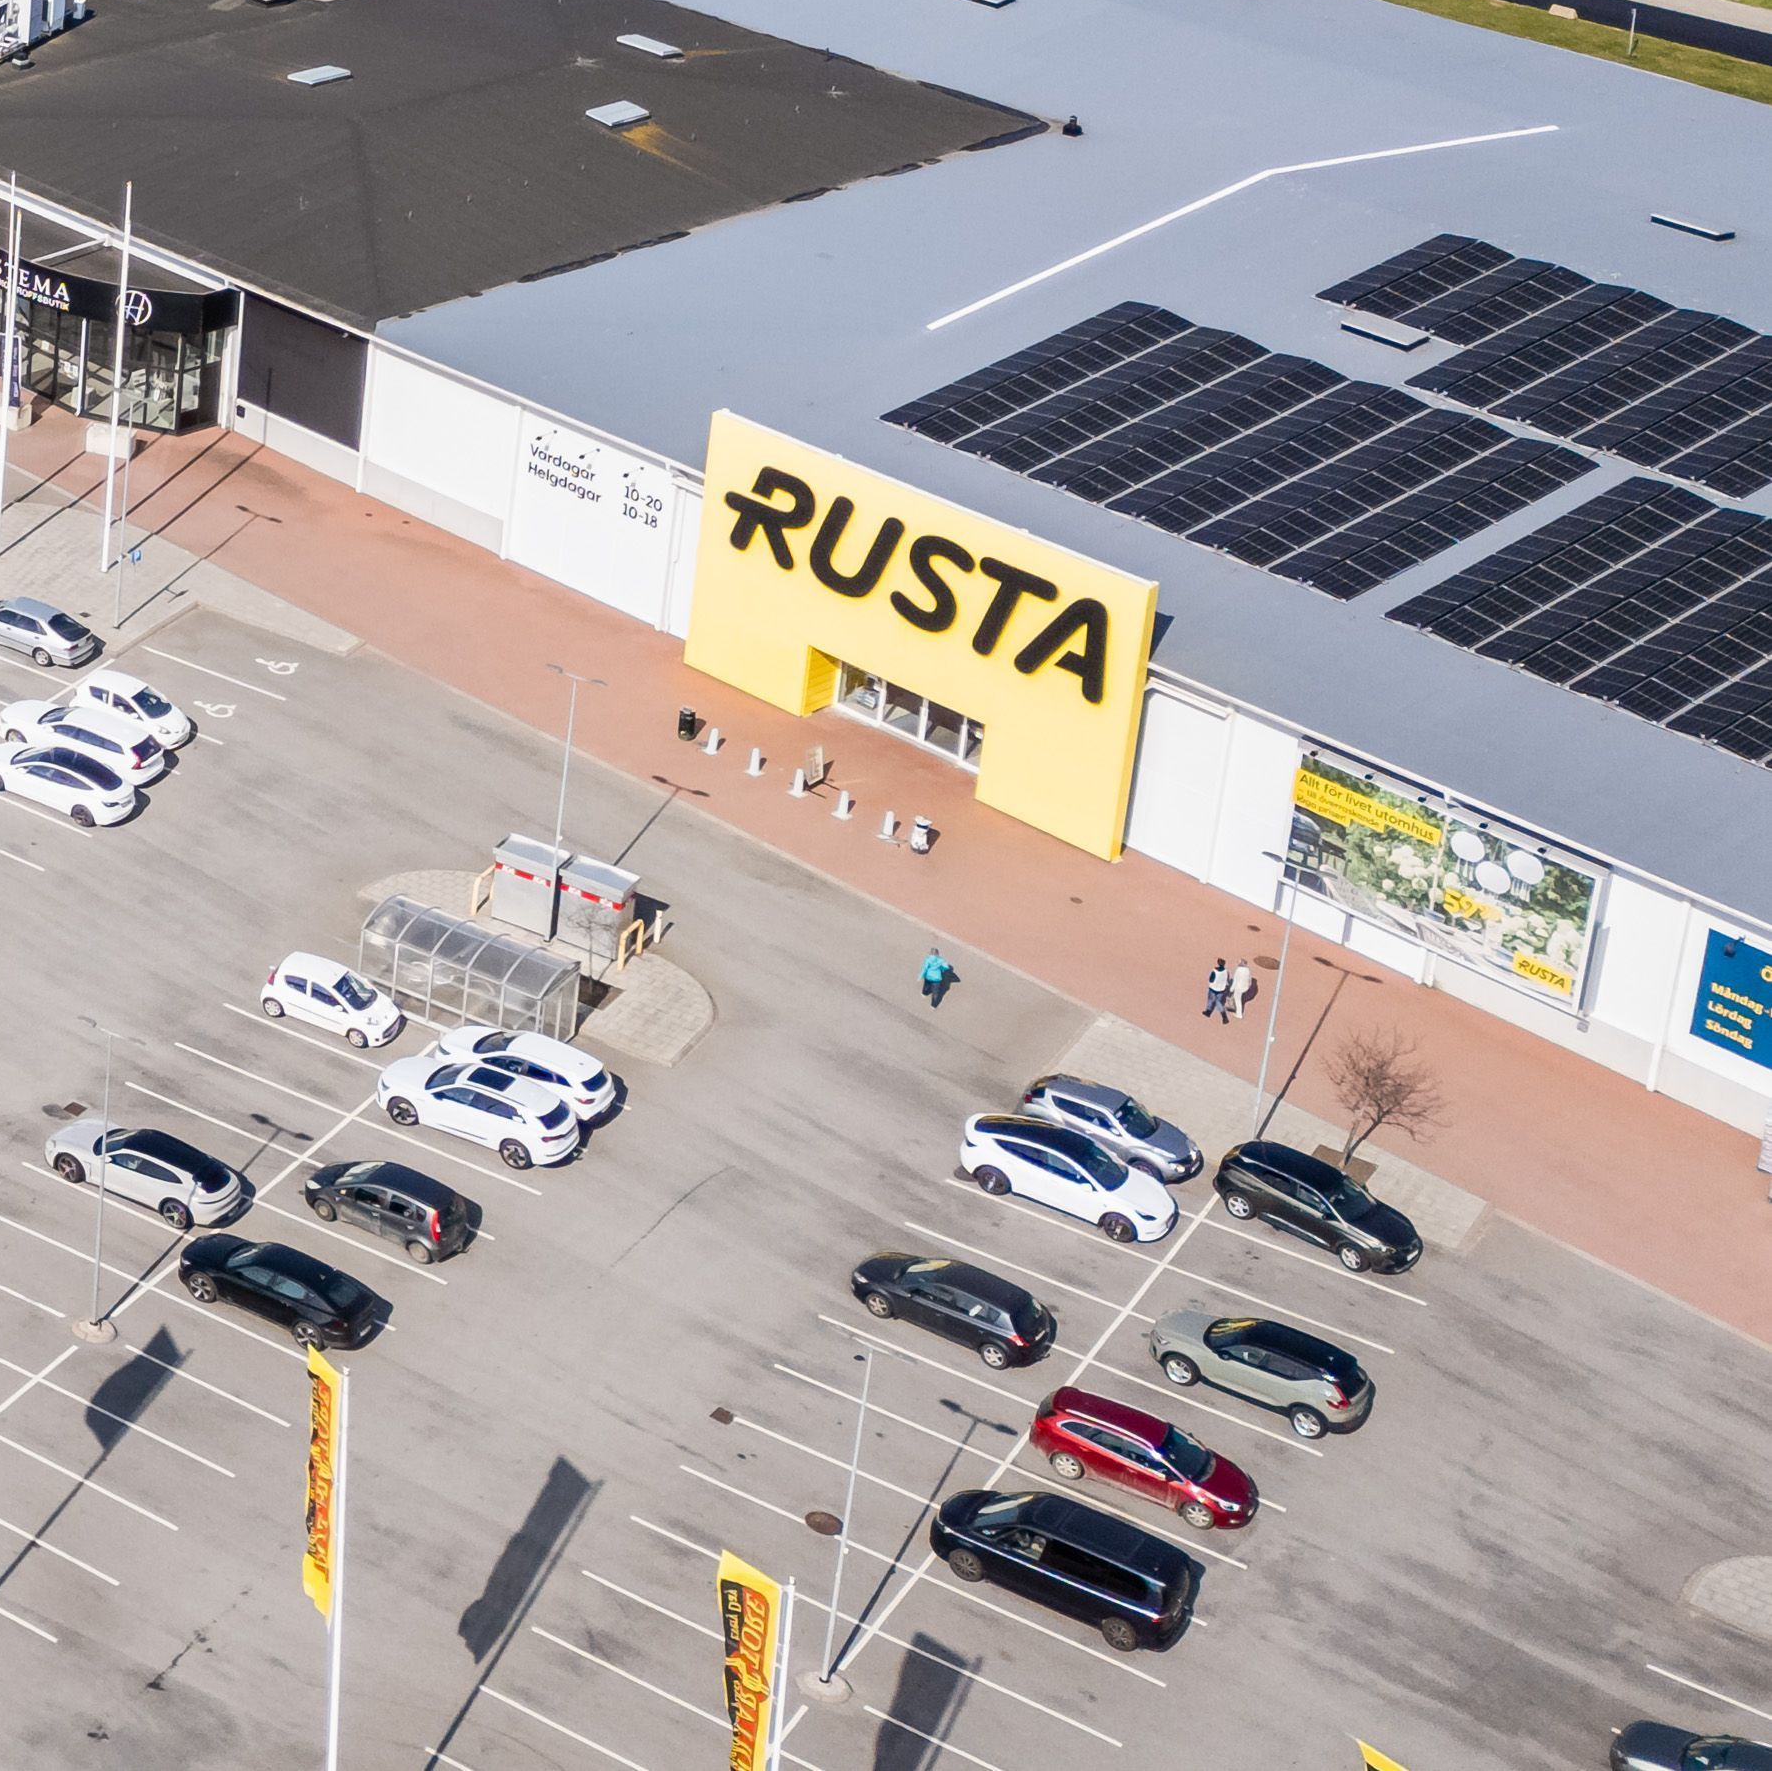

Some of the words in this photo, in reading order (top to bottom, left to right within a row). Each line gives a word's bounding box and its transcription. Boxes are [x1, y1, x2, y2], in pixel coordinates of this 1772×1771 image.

[15, 285, 71, 312] ROFFSBUTIK
[528, 461, 602, 503] Helgdagar
[622, 503, 658, 528] 10-18
[530, 443, 596, 481] Vardagar
[624, 485, 663, 512] 10-20
[724, 465, 1109, 705] RUSTA
[1299, 773, 1321, 789] Allt
[1324, 782, 1343, 798] för
[1345, 792, 1373, 814] livet
[1374, 808, 1434, 842] utomhus
[1518, 959, 1566, 989] RUSTA
[1705, 1018, 1753, 1050] Söndag
[1707, 1000, 1753, 1031] Lördag
